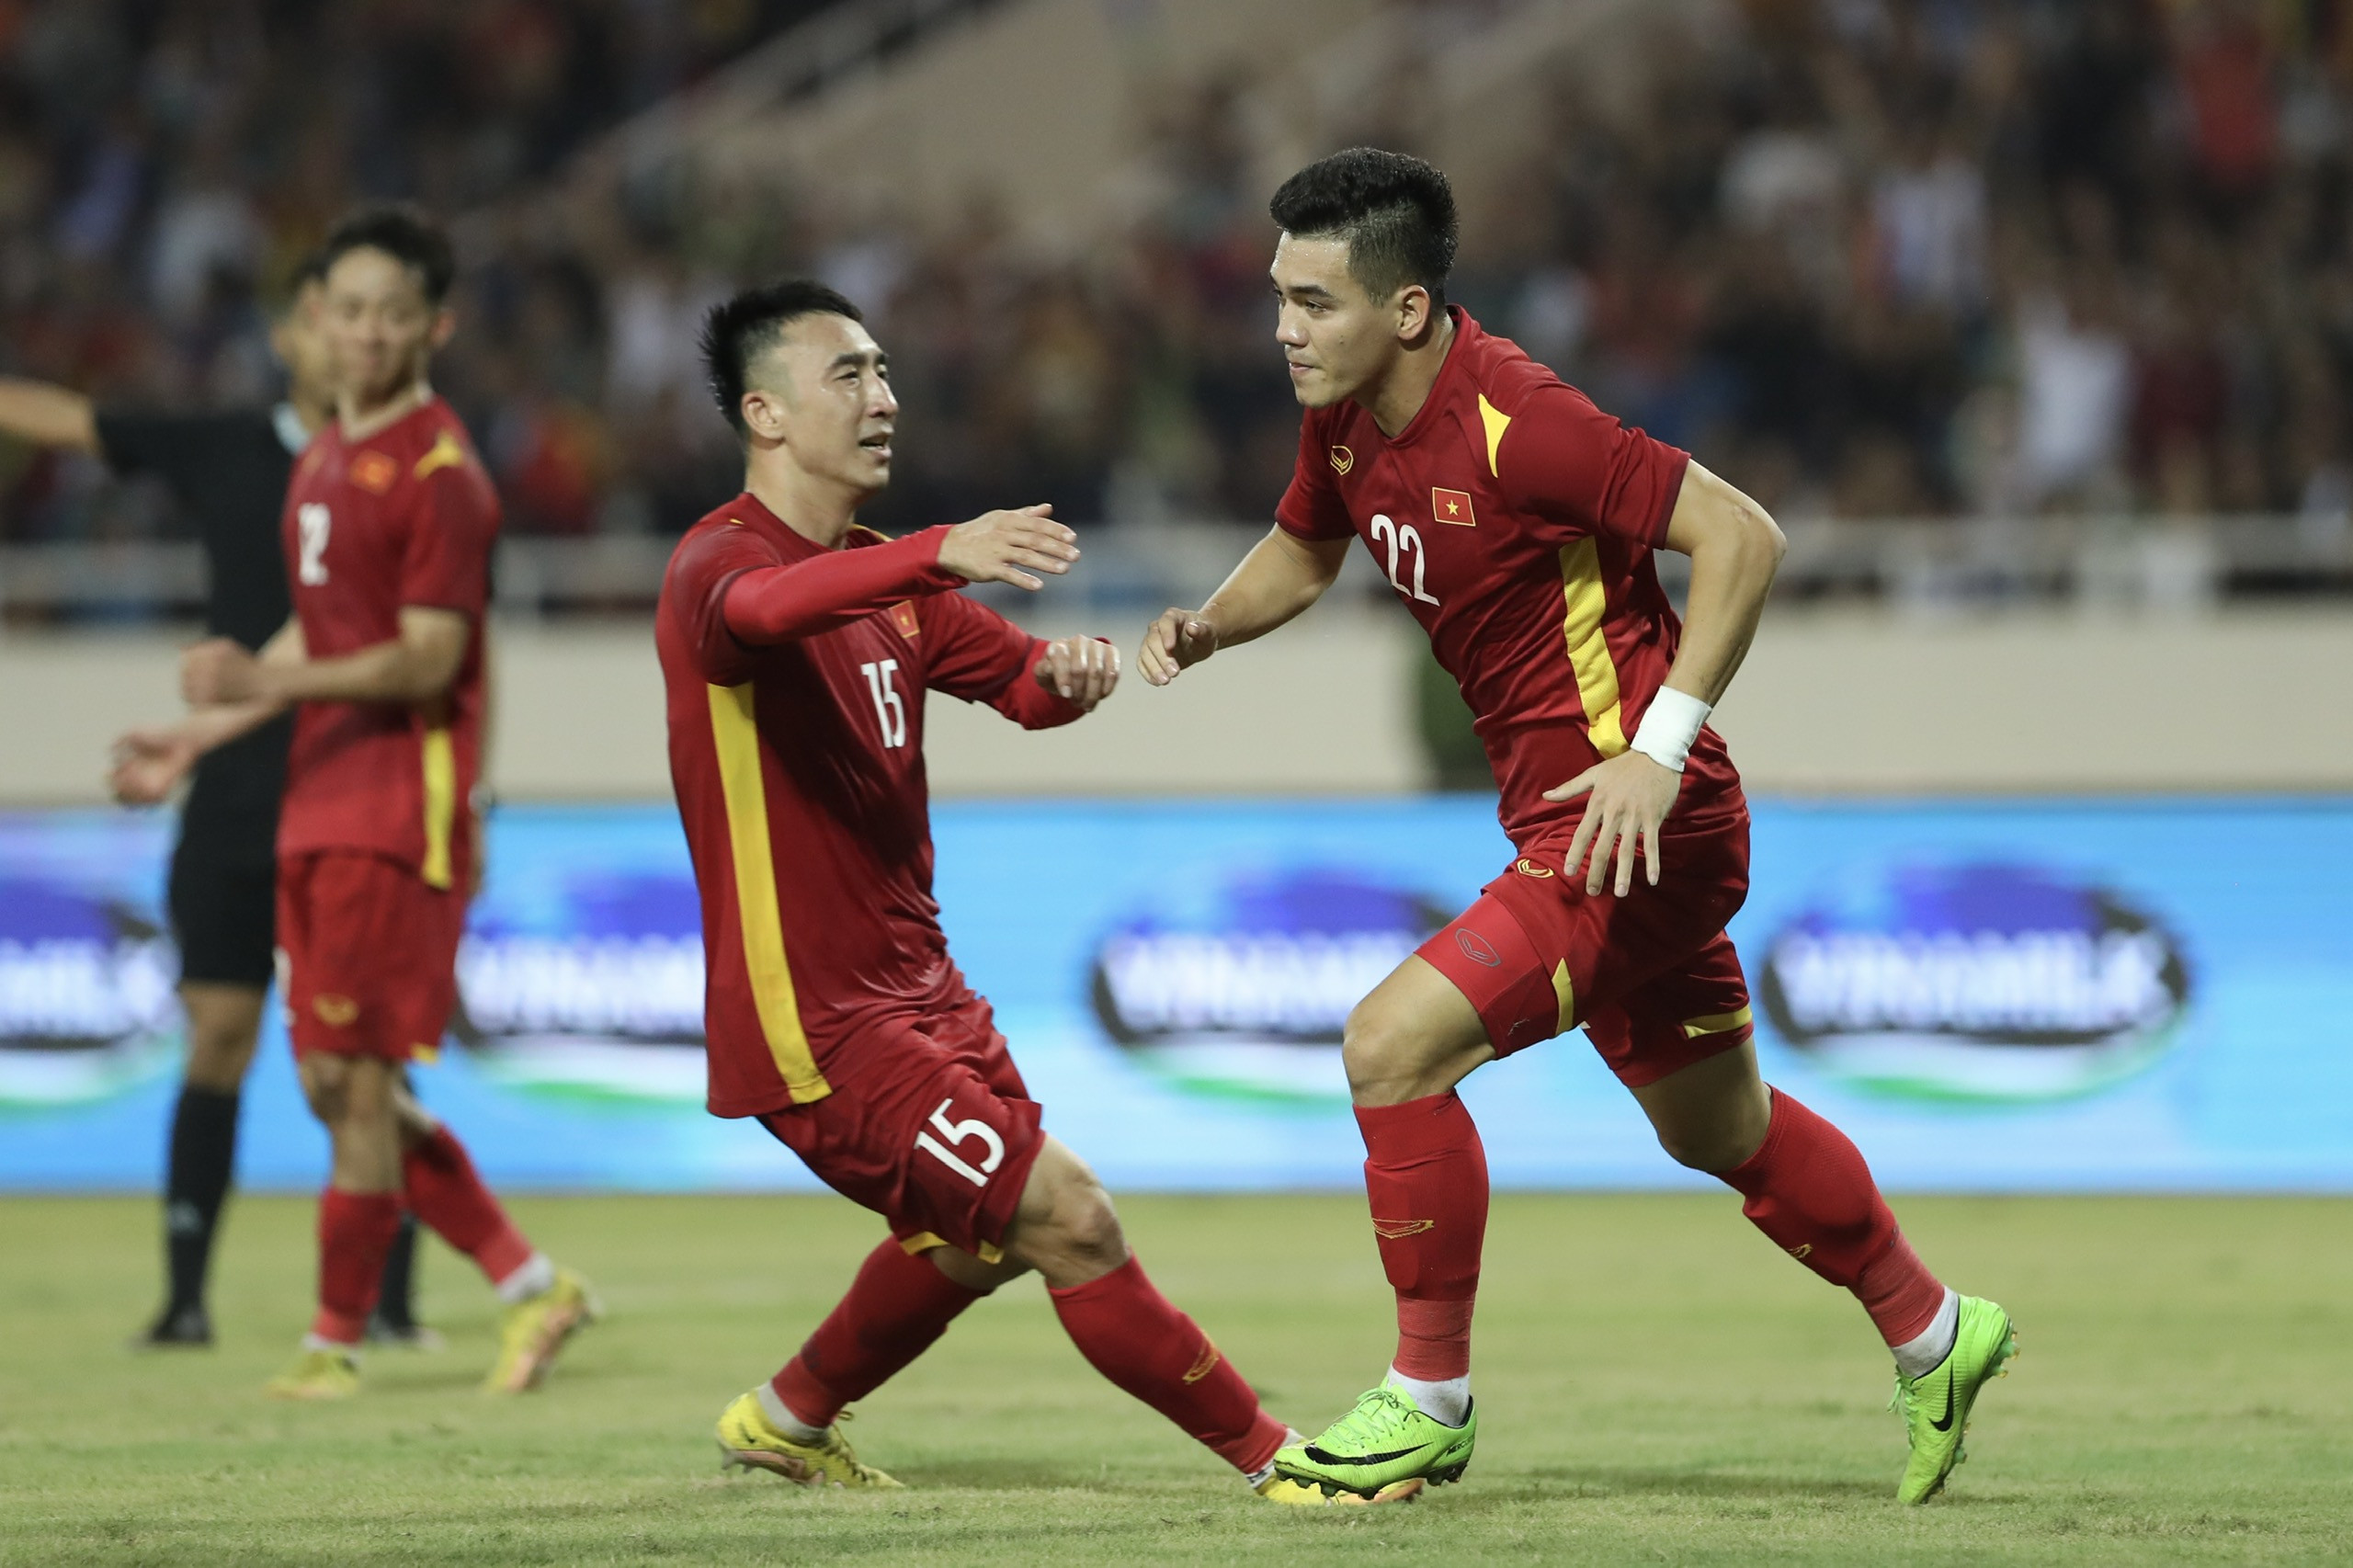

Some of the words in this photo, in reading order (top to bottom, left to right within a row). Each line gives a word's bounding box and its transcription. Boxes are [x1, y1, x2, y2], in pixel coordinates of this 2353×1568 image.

[1370, 514, 1440, 607] 22
[860, 659, 906, 748] 15
[914, 1098, 1005, 1187] 15
